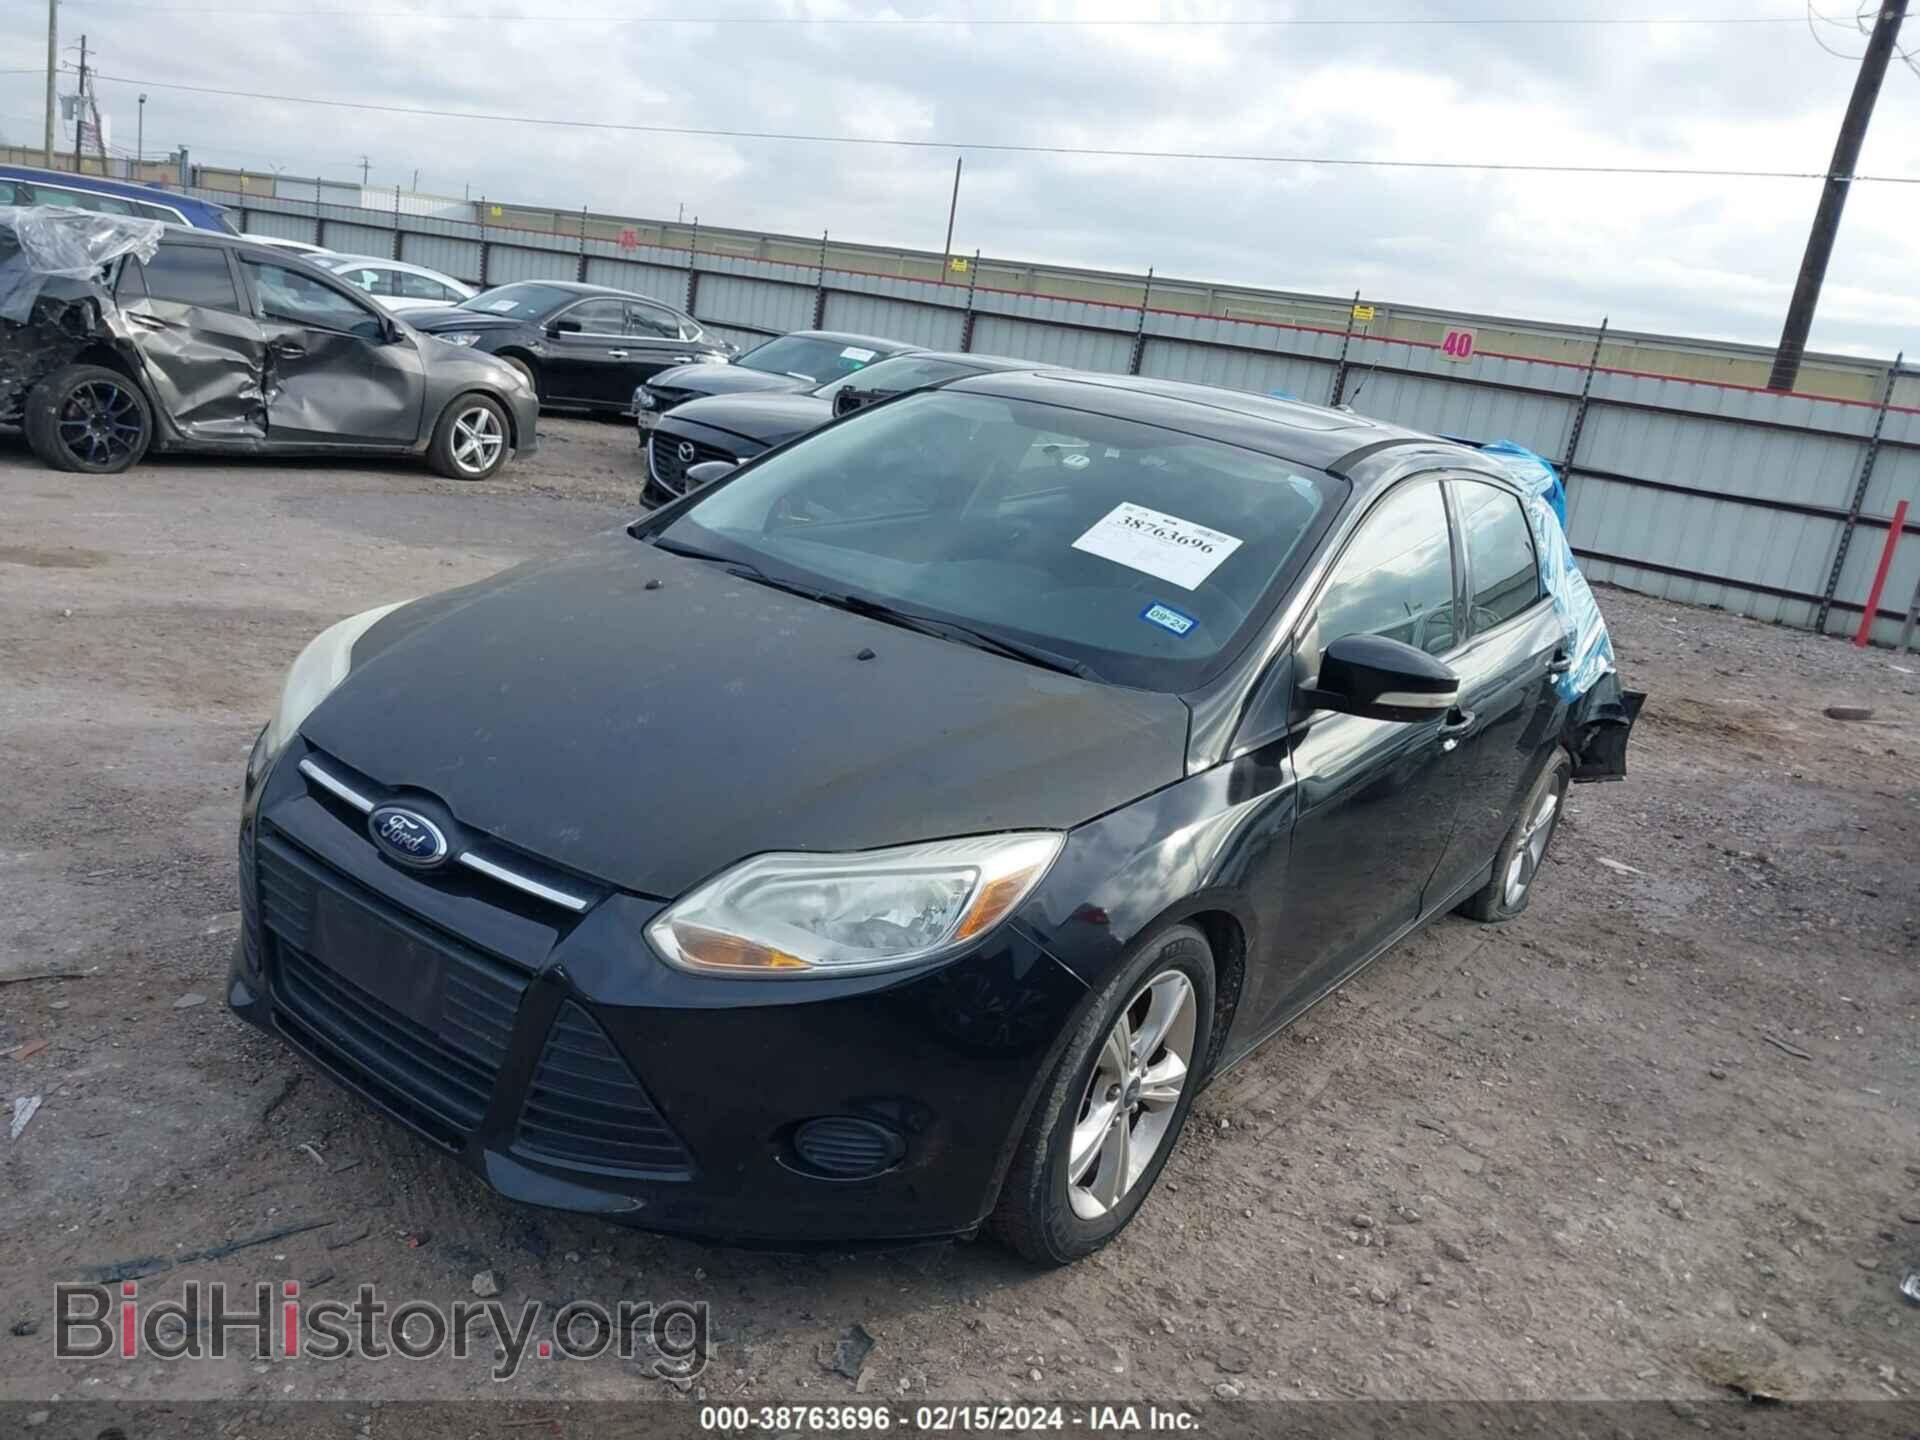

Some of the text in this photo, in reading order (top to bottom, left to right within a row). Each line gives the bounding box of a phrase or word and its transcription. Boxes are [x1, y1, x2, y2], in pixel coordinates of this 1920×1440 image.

[1442, 331, 1473, 358] 40
[1116, 515, 1216, 554] 38763696
[381, 815, 427, 852] Ford
